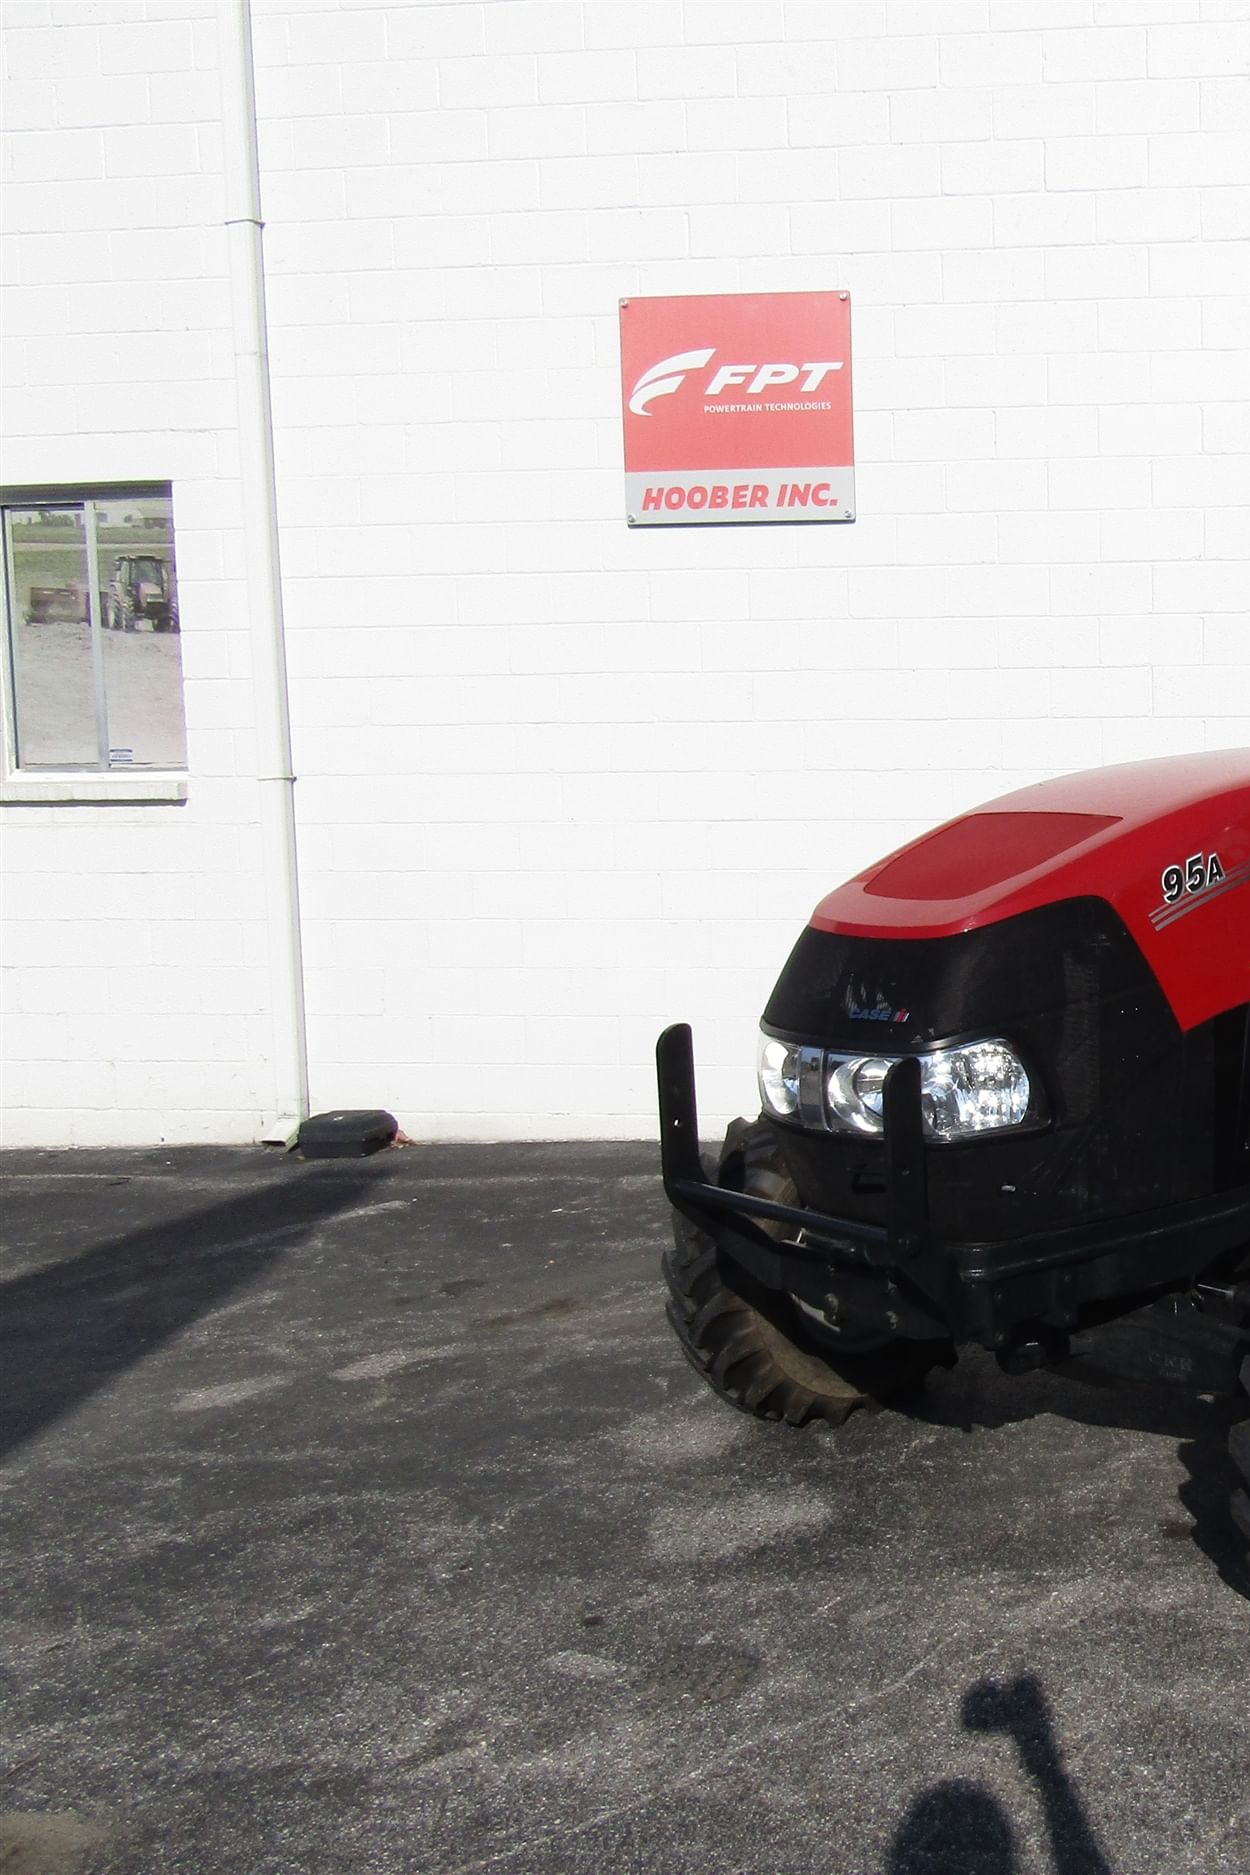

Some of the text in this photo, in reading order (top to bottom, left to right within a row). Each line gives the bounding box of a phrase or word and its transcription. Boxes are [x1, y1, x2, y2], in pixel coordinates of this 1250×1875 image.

[704, 362, 844, 395] FPT
[704, 401, 832, 414] POWERTRAIN TECHNOLOGIES
[641, 482, 838, 512] HOOBER INC.
[1162, 851, 1226, 904] 95A
[849, 1007, 891, 1021] CASE
